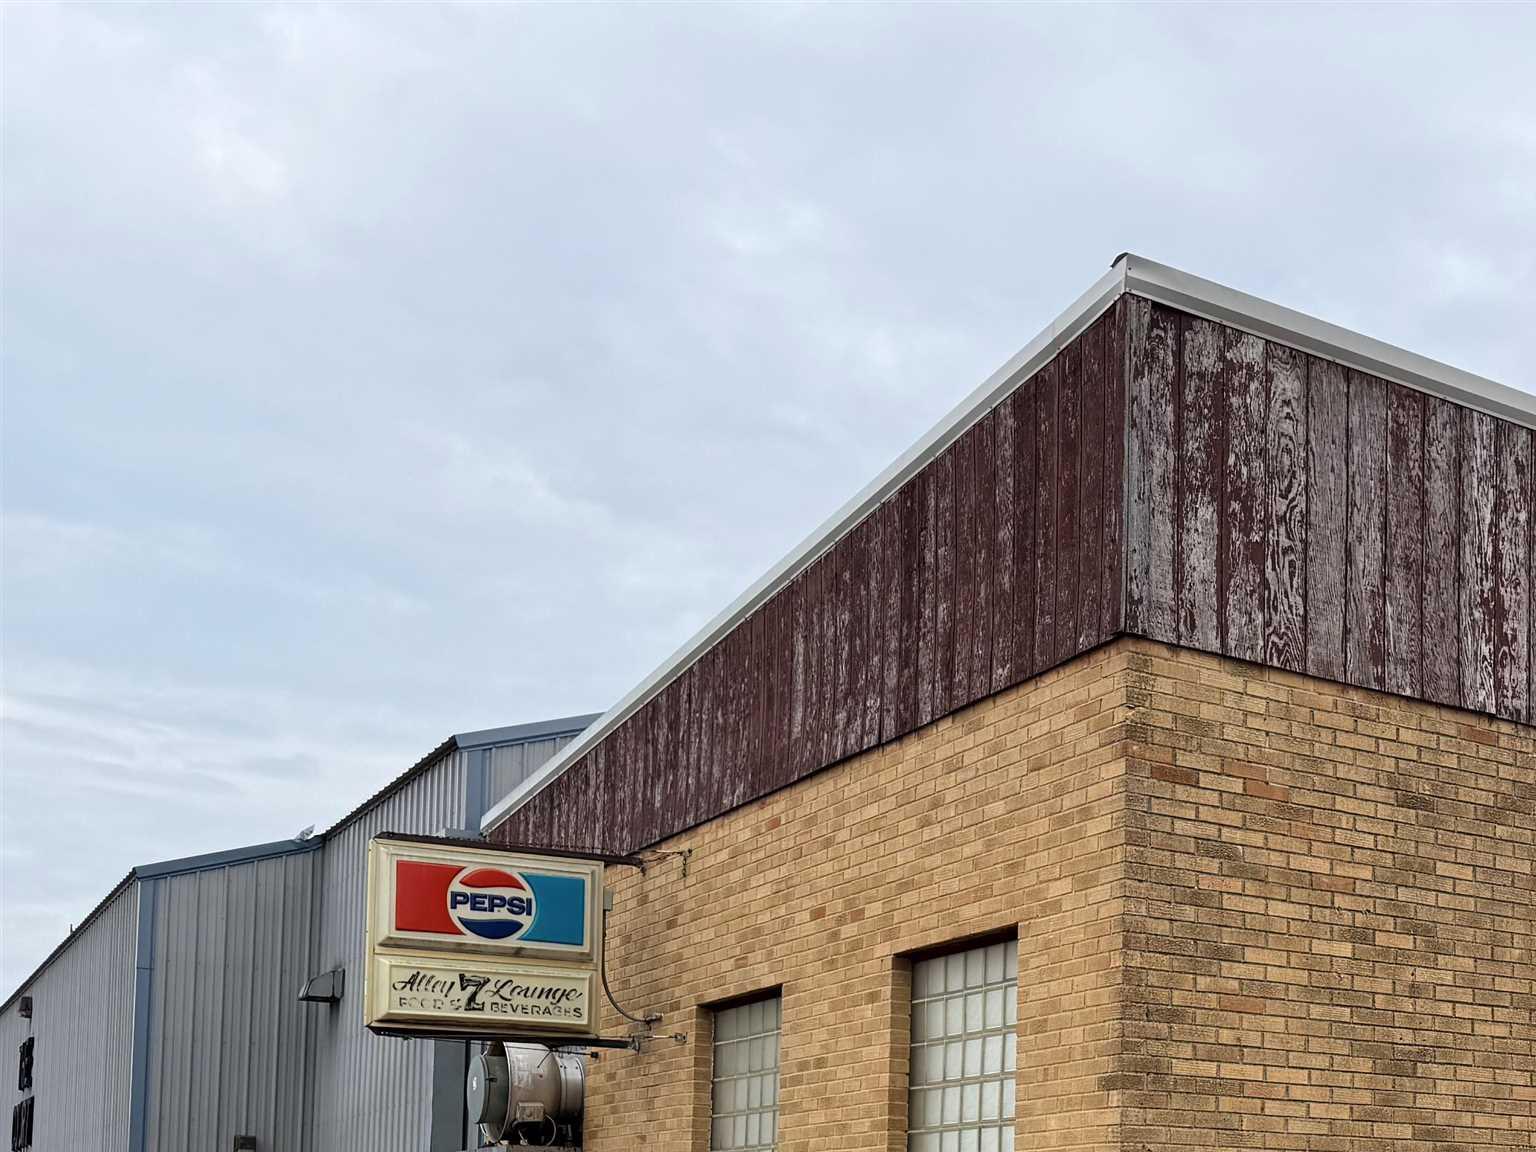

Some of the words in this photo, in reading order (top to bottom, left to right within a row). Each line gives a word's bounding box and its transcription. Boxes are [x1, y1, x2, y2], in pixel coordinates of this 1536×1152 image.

[449, 890, 532, 916] PEPSI
[392, 971, 456, 998] Alley
[458, 973, 490, 1012] 7
[485, 979, 583, 1005] Lounge
